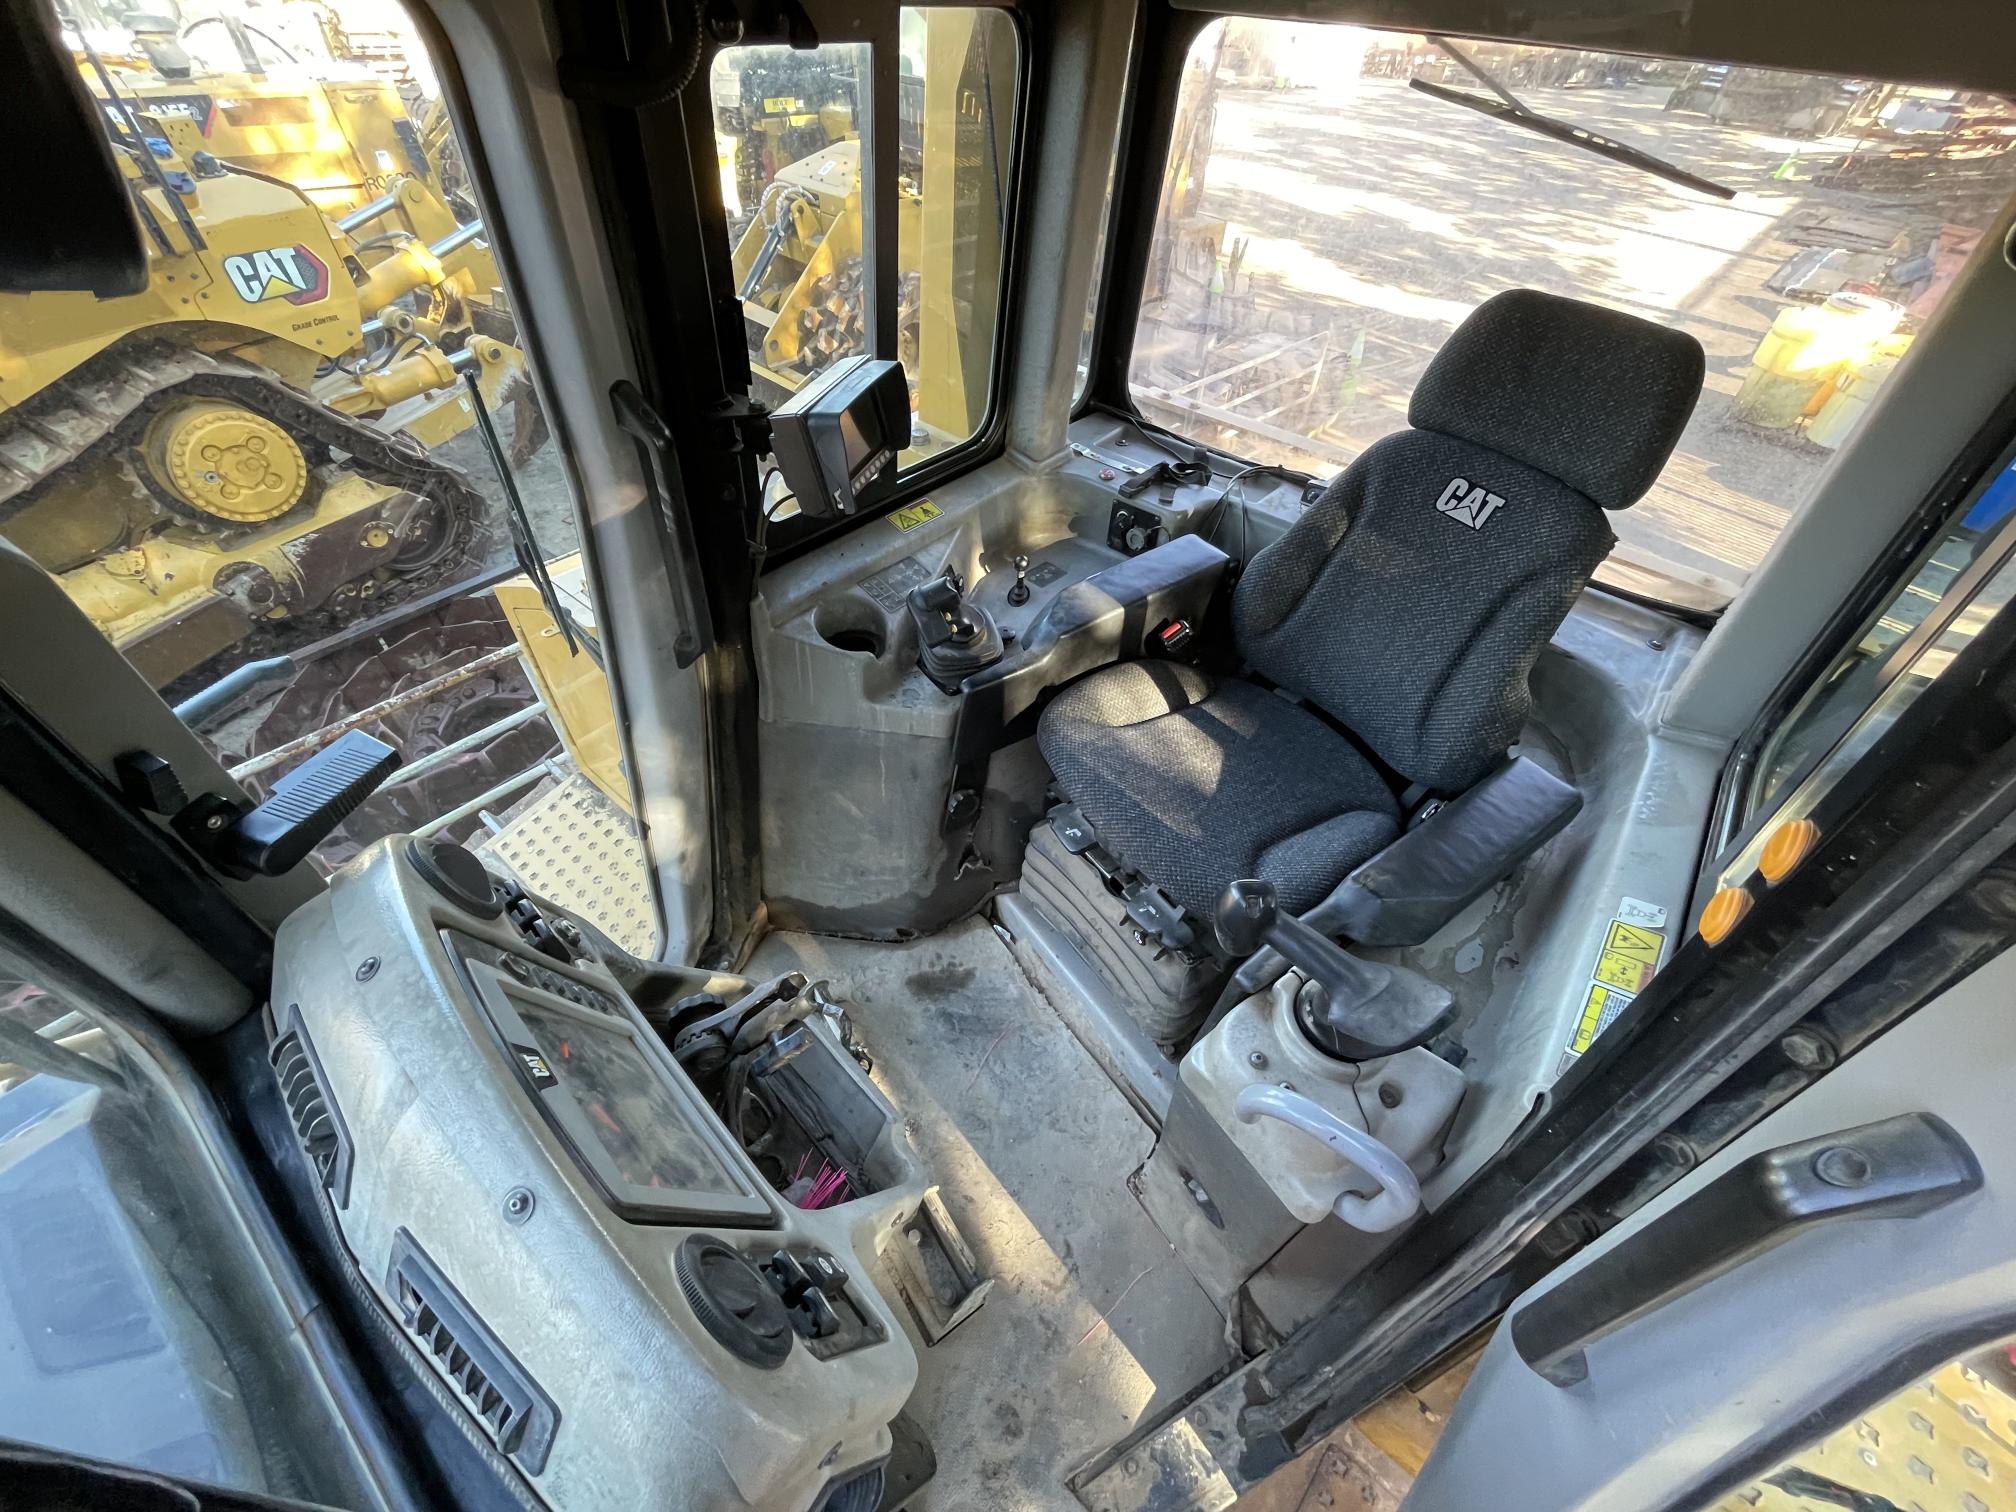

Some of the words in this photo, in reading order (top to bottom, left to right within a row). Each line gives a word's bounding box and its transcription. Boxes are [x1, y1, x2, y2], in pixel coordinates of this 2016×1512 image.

[224, 247, 307, 302] CAT
[314, 315, 340, 326] CONTROL
[1436, 477, 1506, 530] CAT
[521, 1053, 550, 1077] CAT
